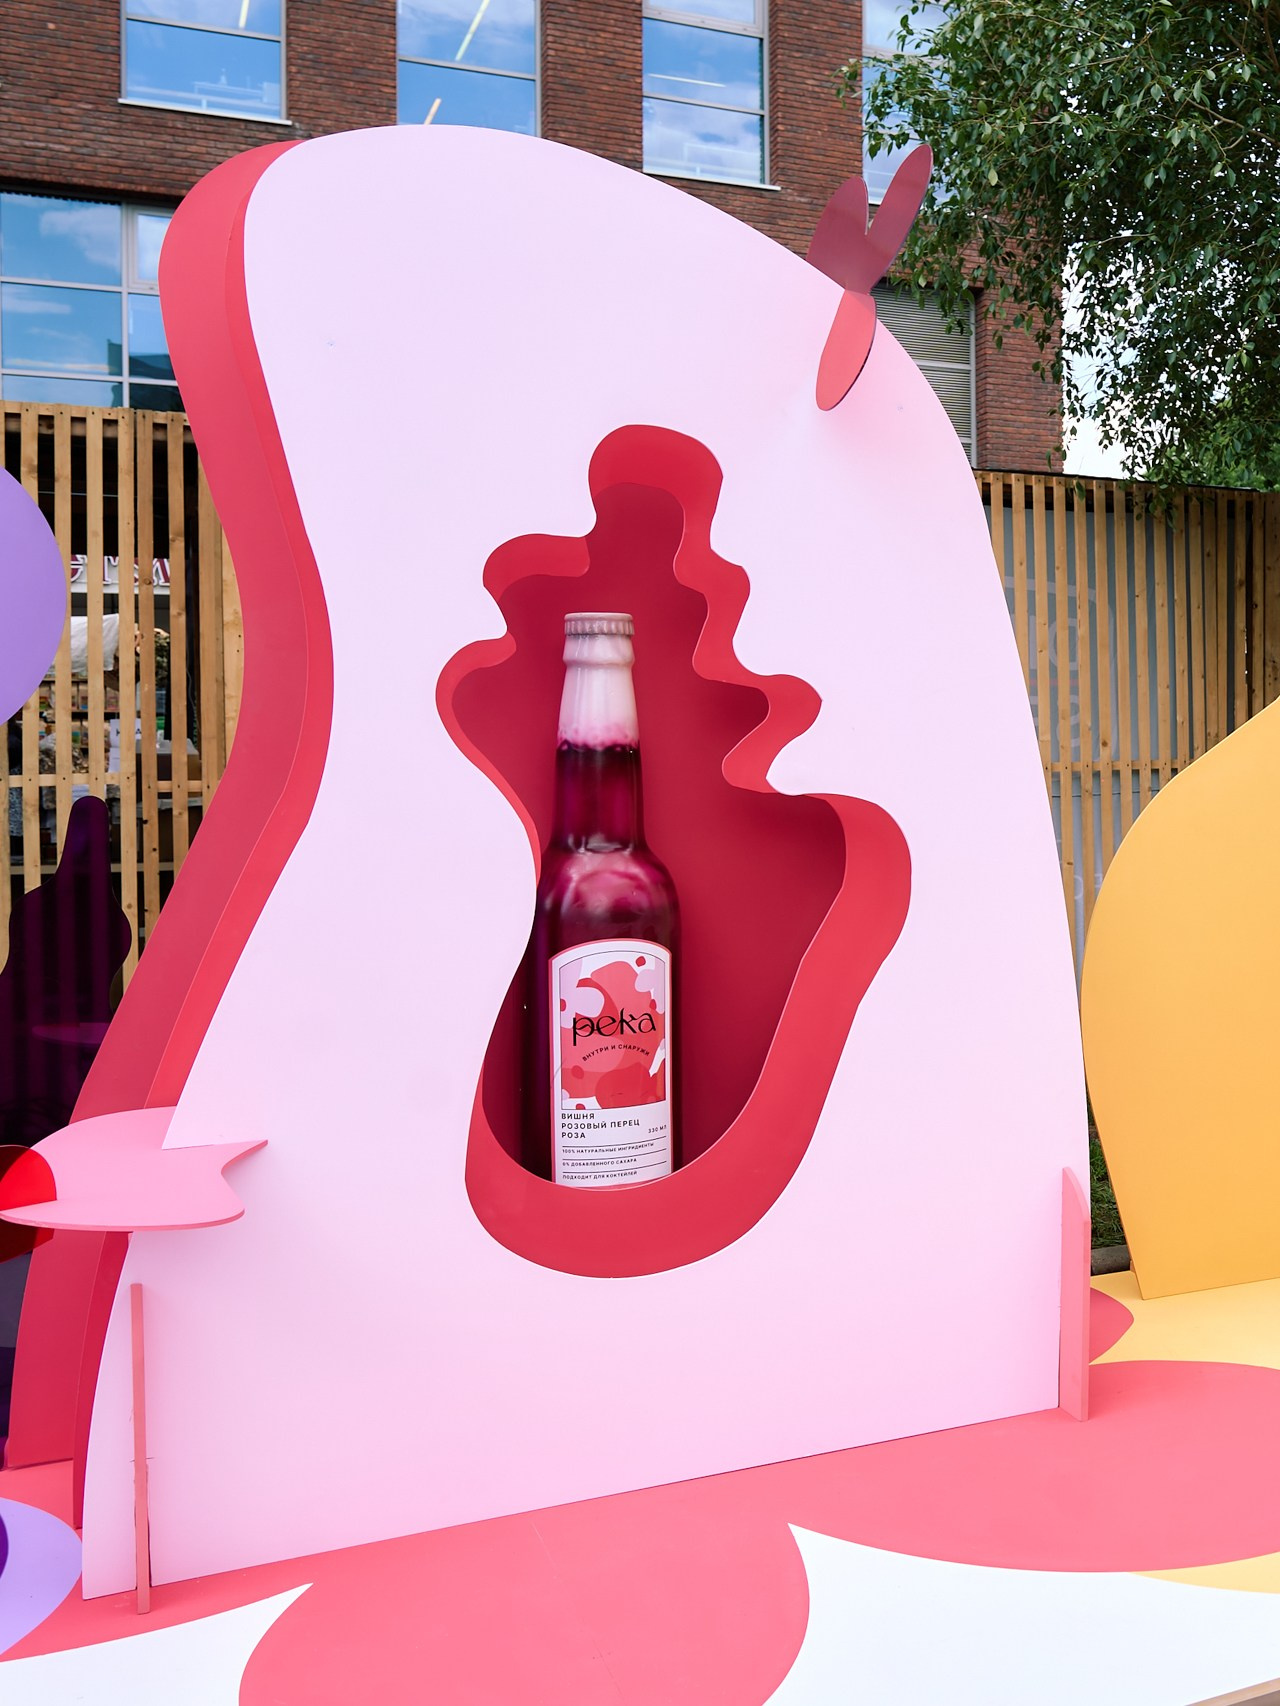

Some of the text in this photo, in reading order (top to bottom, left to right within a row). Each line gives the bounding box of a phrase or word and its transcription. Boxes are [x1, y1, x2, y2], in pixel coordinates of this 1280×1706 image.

[582, 1046, 609, 1062] ВНУТРИ
[618, 1044, 650, 1056] СНАРУЖИ
[561, 1119, 640, 1130] РОЗОВЫЙ ПЕРЕЦ
